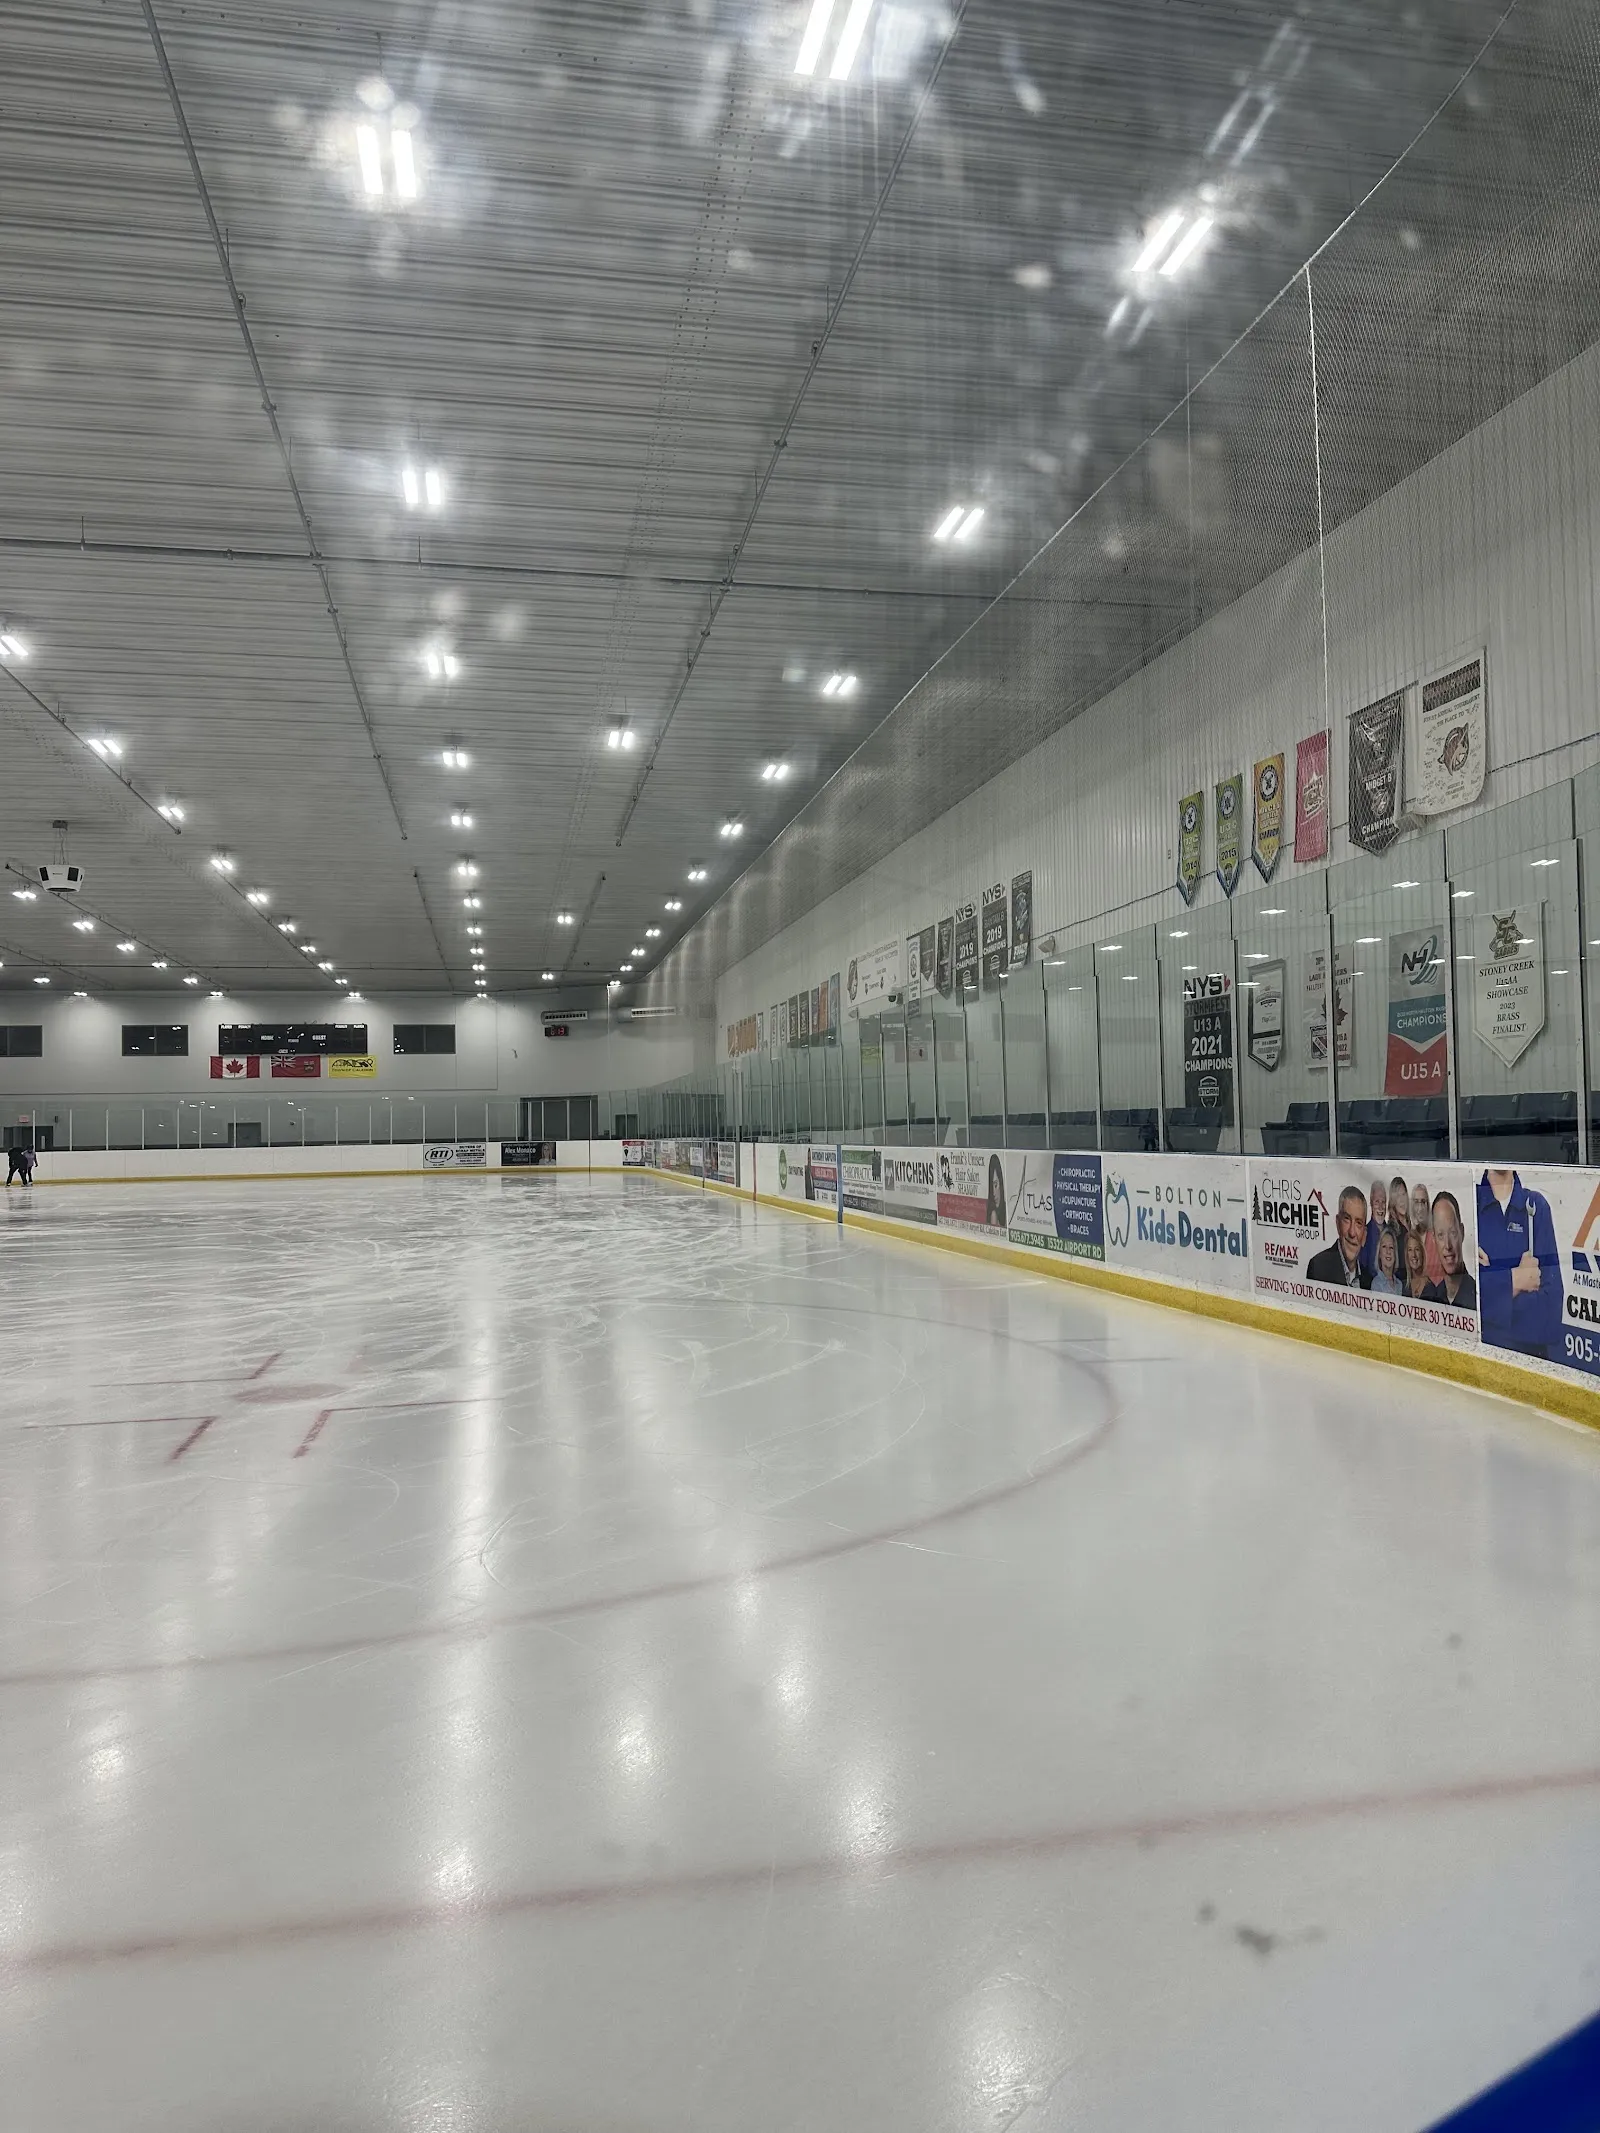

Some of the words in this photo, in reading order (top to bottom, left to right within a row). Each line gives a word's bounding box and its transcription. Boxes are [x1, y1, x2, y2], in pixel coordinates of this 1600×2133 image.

[982, 883, 1001, 906] NYS
[987, 925, 1002, 943] 2019
[960, 942, 974, 960] 2019
[1479, 964, 1507, 977] STONEY
[1508, 960, 1535, 973] CREEK
[1184, 972, 1223, 1000] NYS
[1486, 985, 1529, 1000] SHOWCASE
[1499, 1001, 1516, 1010] 2023
[1193, 1017, 1212, 1032] U13
[1214, 1016, 1222, 1030] A
[1397, 1012, 1447, 1029] CHAMPIONS
[1497, 1012, 1520, 1022] BRASS
[1492, 1023, 1527, 1035] FINALIST
[1191, 1034, 1223, 1057] 2021
[1185, 1056, 1233, 1072] CHAMPIONS
[1400, 1063, 1428, 1081] U15
[1431, 1061, 1442, 1078] A
[1198, 1086, 1220, 1097] STORM
[430, 1150, 449, 1158] RTI
[894, 1160, 934, 1186] KITCHENS
[955, 1168, 966, 1181] Hair
[967, 1169, 980, 1182] Salon
[1060, 1167, 1096, 1179] CHIROPRACTIC
[1008, 1155, 1053, 1225] ATLAS
[1056, 1180, 1079, 1192] PHYSICAL
[1079, 1182, 1101, 1194] THERAPY
[1261, 1177, 1302, 1201] CHRIS
[1061, 1195, 1097, 1208] ACUPUNCTURE
[1155, 1185, 1221, 1208] BOLTON
[1065, 1210, 1093, 1222] ORTHOTICS
[1263, 1201, 1320, 1228] RICHIE
[1070, 1224, 1090, 1236] BRACES
[1136, 1205, 1176, 1246] Kids
[1178, 1210, 1248, 1258] Dental
[1295, 1229, 1320, 1241] GROUP
[1010, 1230, 1045, 1248] 905.677.3945
[1047, 1237, 1064, 1251] 15322
[1064, 1239, 1092, 1257] AIRPORT
[1092, 1245, 1102, 1259] RD
[1264, 1242, 1299, 1260] RE/MAX
[1573, 1273, 1581, 1286] At
[1255, 1275, 1289, 1294] SERVING
[1290, 1282, 1316, 1299] YOUR
[1315, 1287, 1376, 1313] COMMUNITY
[1376, 1299, 1398, 1315] FOR
[1398, 1304, 1429, 1322] OVER
[1429, 1308, 1440, 1325] 30
[1441, 1311, 1475, 1333] YEARS
[1566, 1294, 1600, 1324] CAL
[1565, 1333, 1600, 1363] 905-
